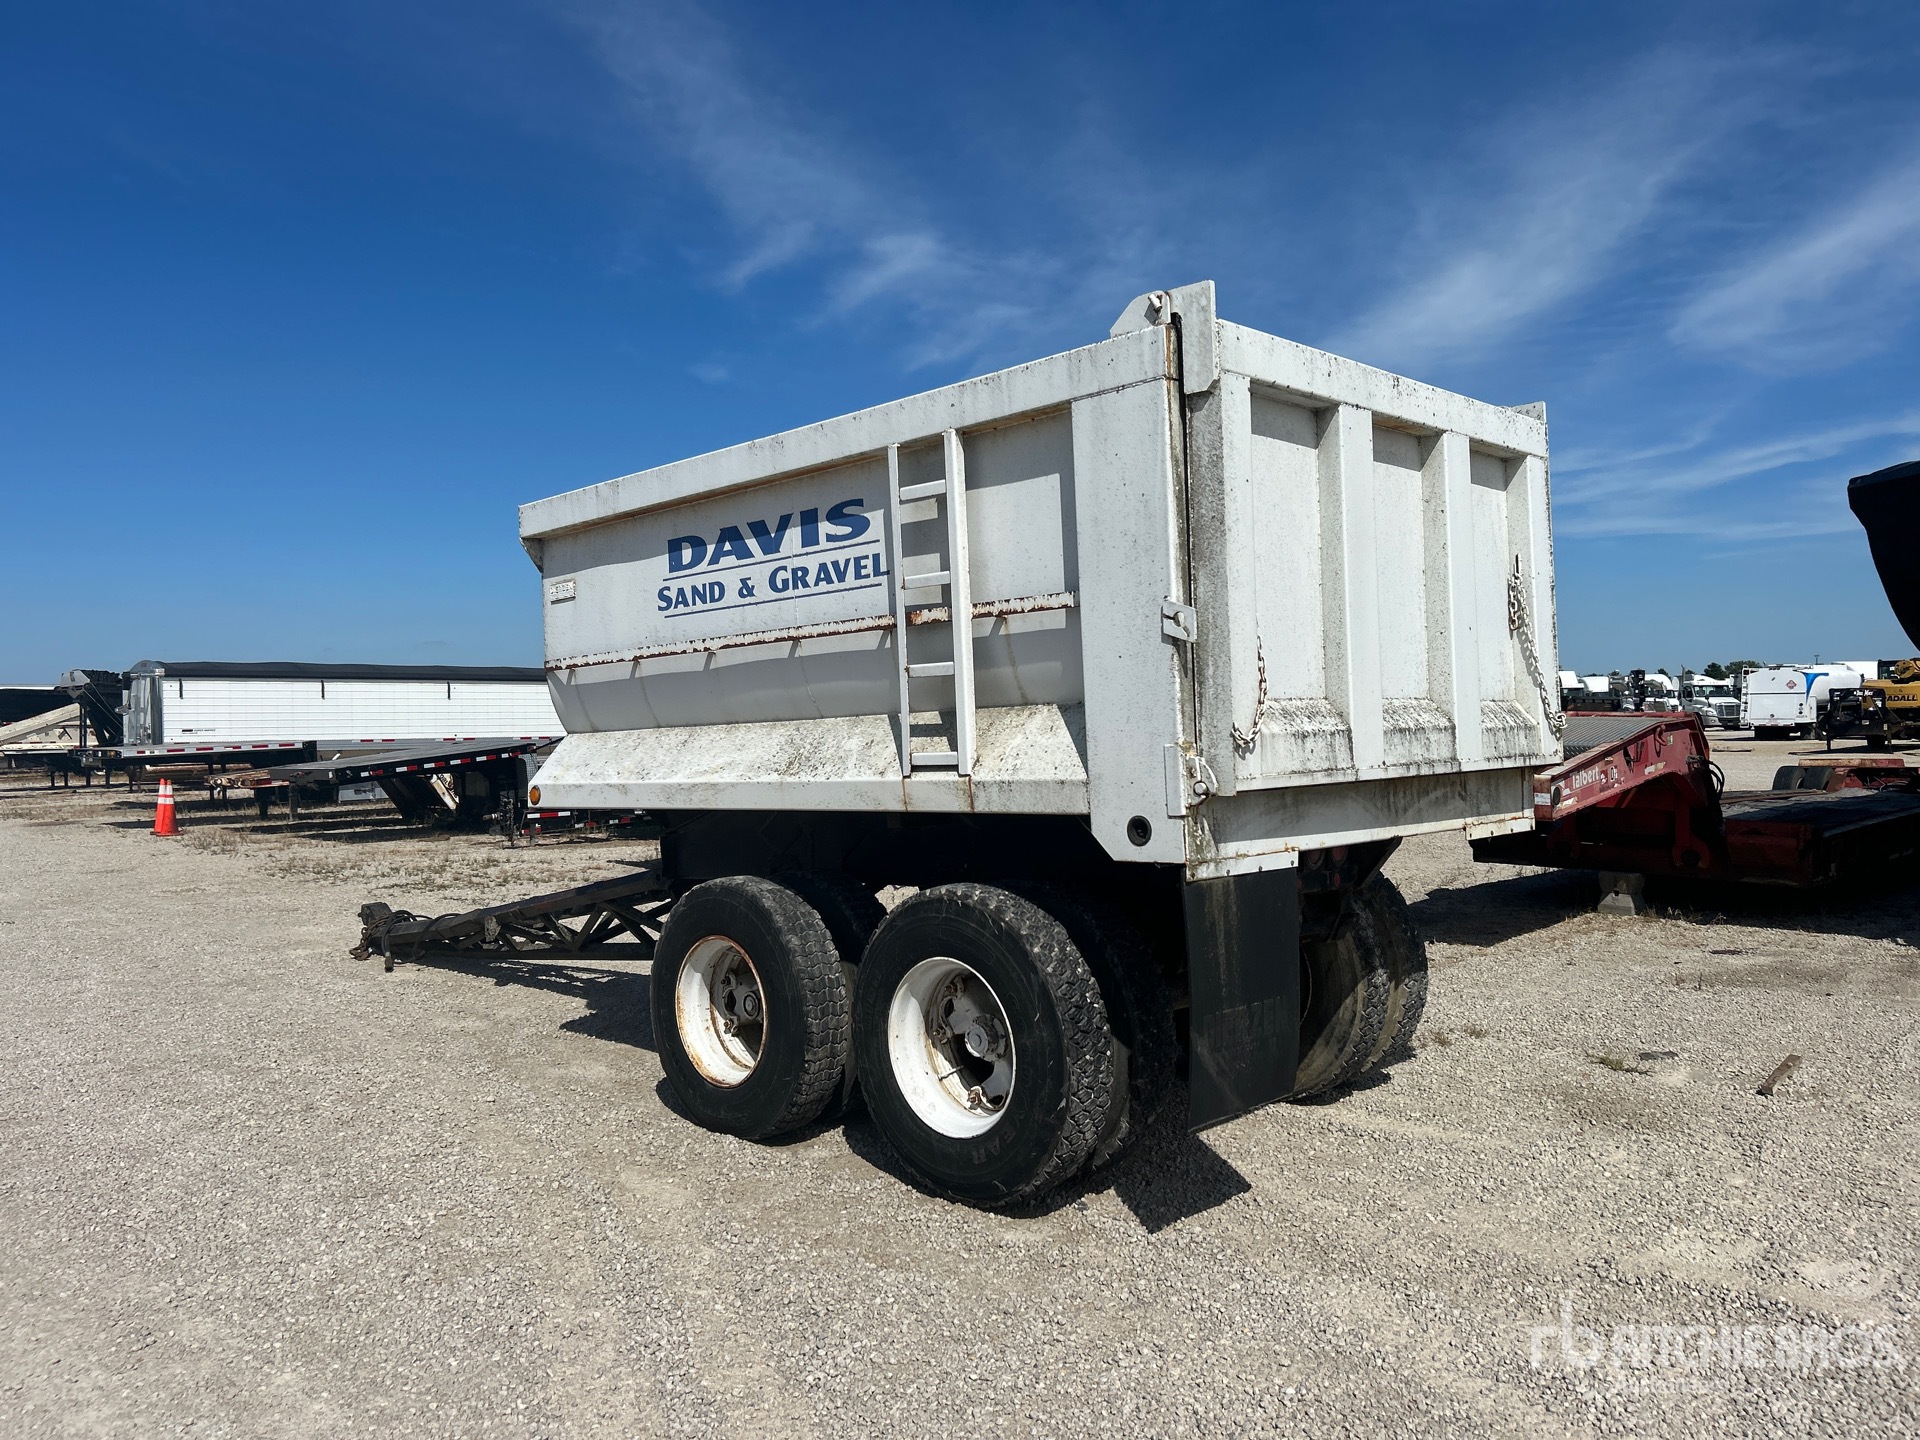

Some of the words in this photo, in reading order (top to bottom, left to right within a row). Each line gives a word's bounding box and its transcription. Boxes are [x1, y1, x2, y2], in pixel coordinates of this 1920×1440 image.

[667, 498, 870, 574] DAVIS
[658, 581, 725, 611] SAND
[738, 577, 756, 599] &
[769, 552, 890, 593] GRAVEL
[1887, 694, 1918, 702] ADALL
